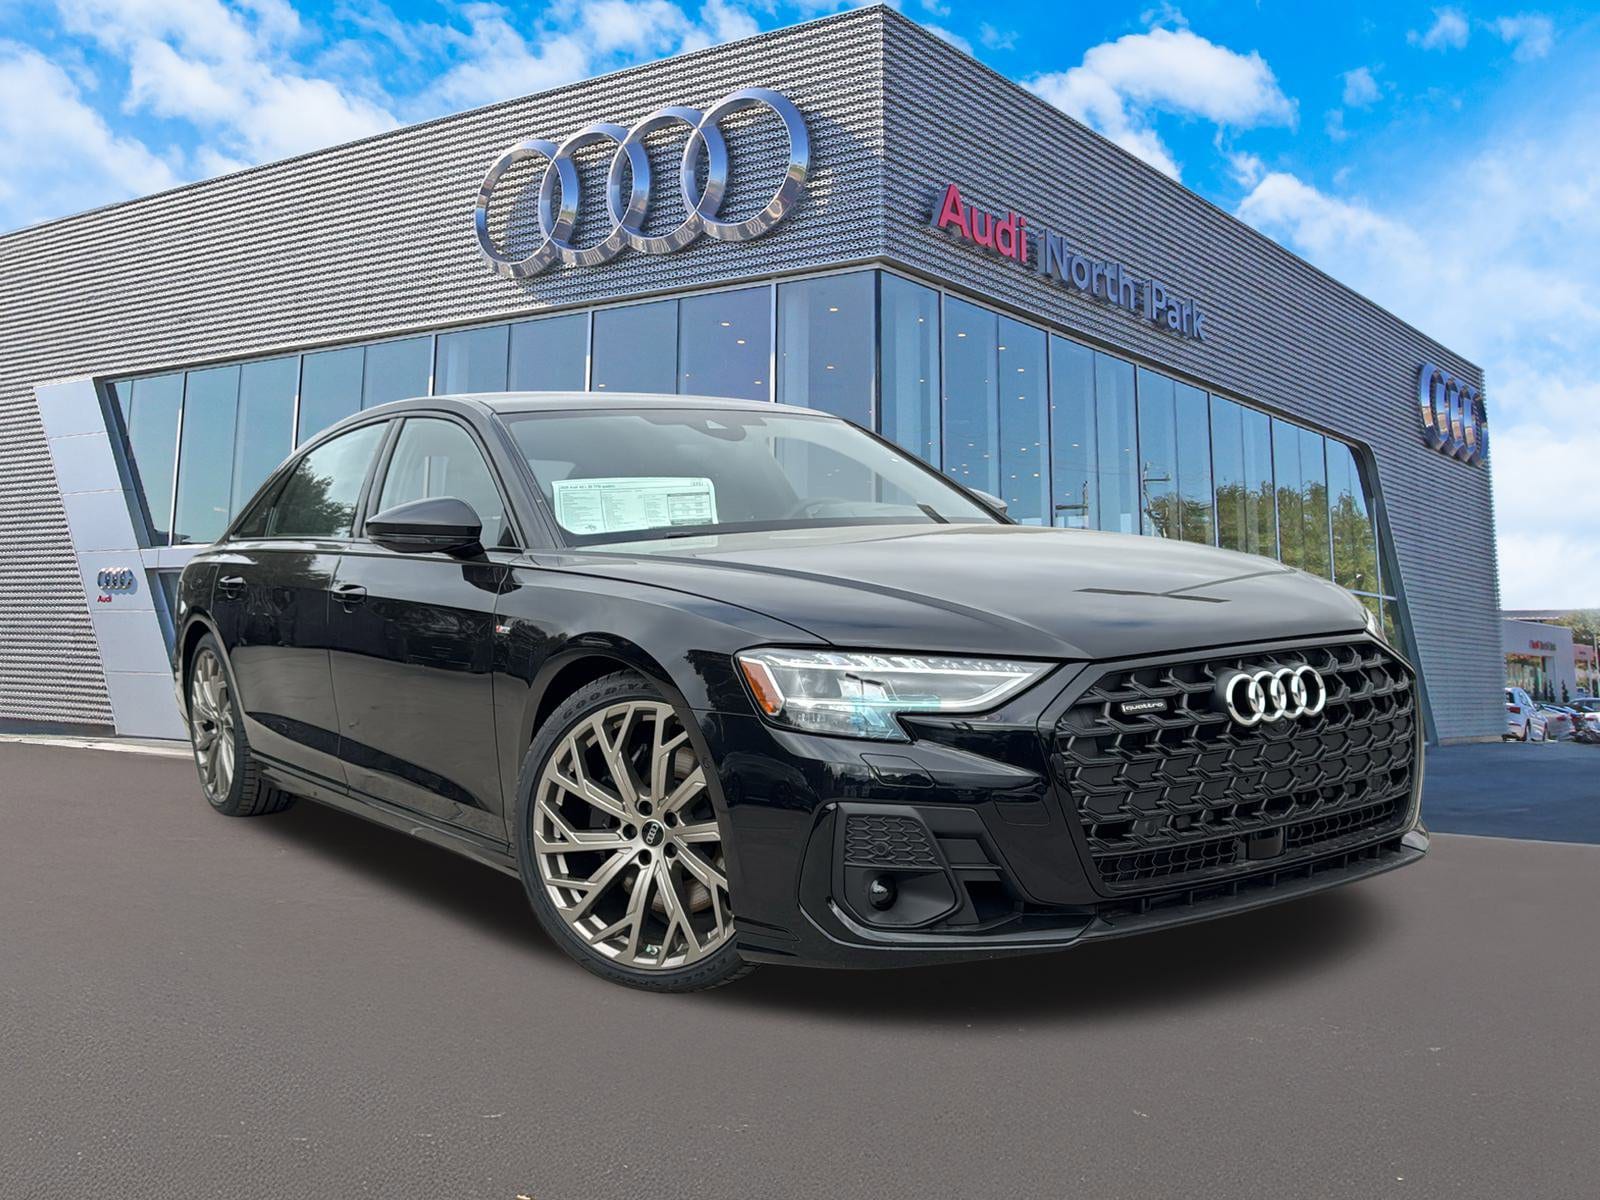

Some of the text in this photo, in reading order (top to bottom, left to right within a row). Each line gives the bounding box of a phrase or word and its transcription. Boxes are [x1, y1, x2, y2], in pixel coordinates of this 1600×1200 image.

[935, 183, 1207, 341] Audi North Park
[1125, 702, 1164, 711] quattro
